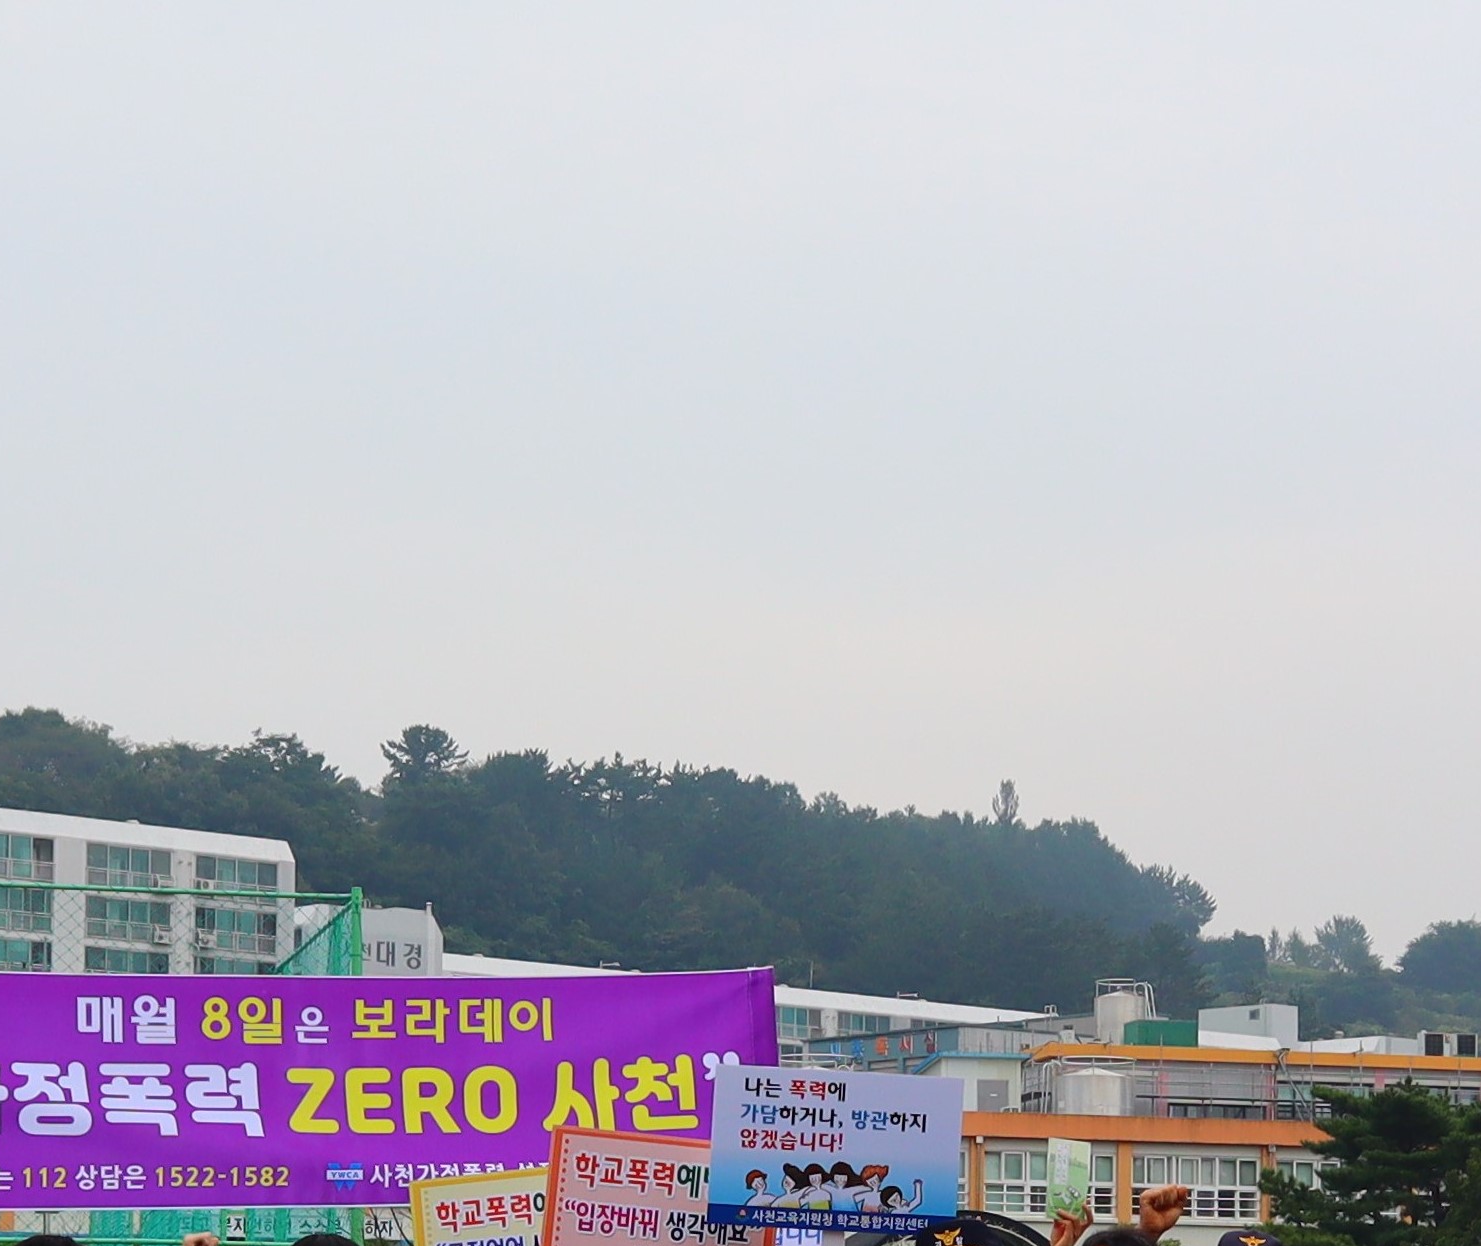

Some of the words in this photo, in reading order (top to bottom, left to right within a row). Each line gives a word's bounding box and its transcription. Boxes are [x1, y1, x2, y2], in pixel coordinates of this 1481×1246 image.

[76, 996, 177, 1045] 매월
[352, 996, 554, 1044] 보라데이
[287, 1065, 517, 1134] ZERO
[744, 1077, 782, 1098] 나는
[789, 1079, 847, 1102] 폭력에
[740, 1103, 843, 1129] 가담하거나,
[852, 1110, 927, 1133] 방관하지
[740, 1128, 843, 1152] 않겠습니다!
[23, 1167, 66, 1189] 112
[75, 1164, 147, 1189] 상담은
[155, 1165, 290, 1188] 1522-1582
[574, 1152, 711, 1200] 학교폭력예
[751, 1209, 833, 1227] 사천교육지원청
[837, 1213, 929, 1231] 학교통합지원센터
